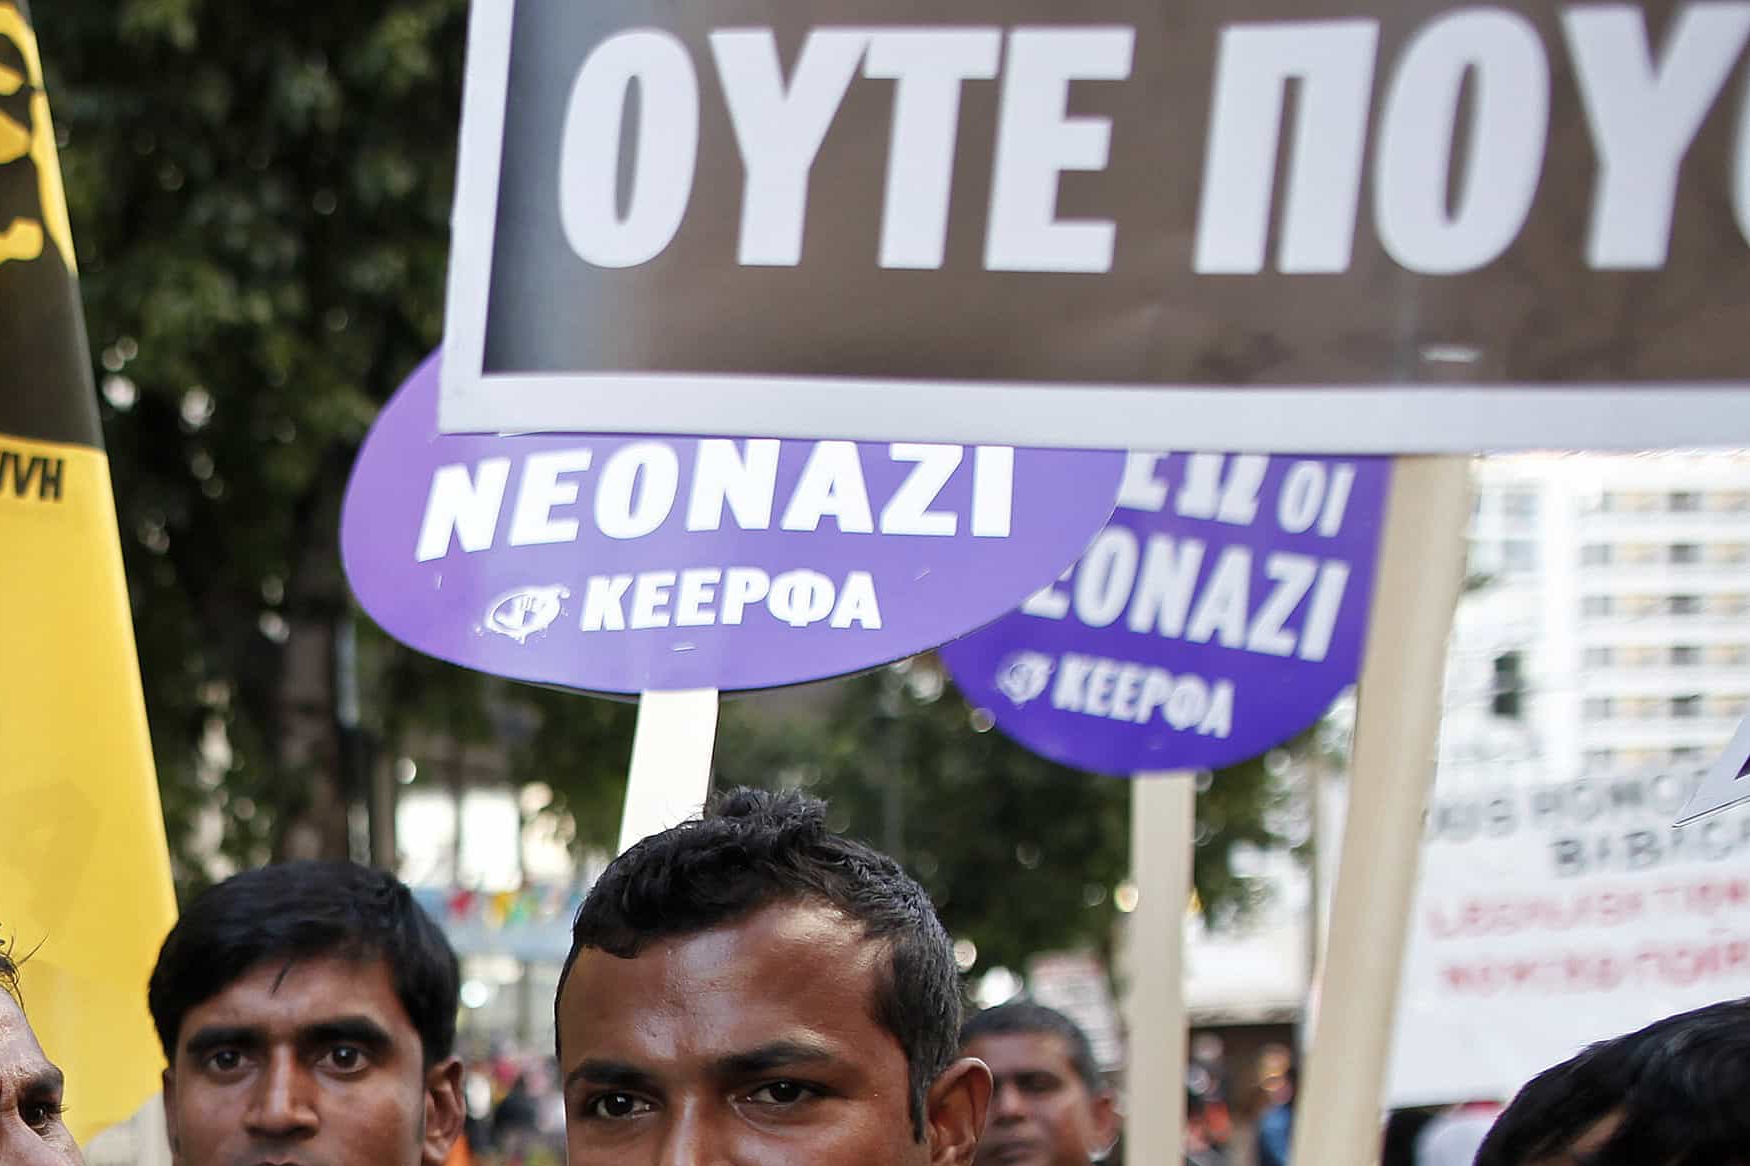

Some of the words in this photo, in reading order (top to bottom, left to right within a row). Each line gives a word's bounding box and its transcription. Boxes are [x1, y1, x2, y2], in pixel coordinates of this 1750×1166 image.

[558, 25, 1137, 274] ΟΥΤΕ
[1192, 5, 1750, 276] ΠΟΥ
[416, 438, 1015, 563] ΝΕΟΝΑΖΙ
[1277, 460, 1357, 538] ΟΙ
[581, 567, 882, 631] ΚΕΕΡΦΑ
[1021, 524, 1351, 663] ΟΝΑΖΙ
[1053, 650, 1235, 740] ΚΕΕΡΦΑ
